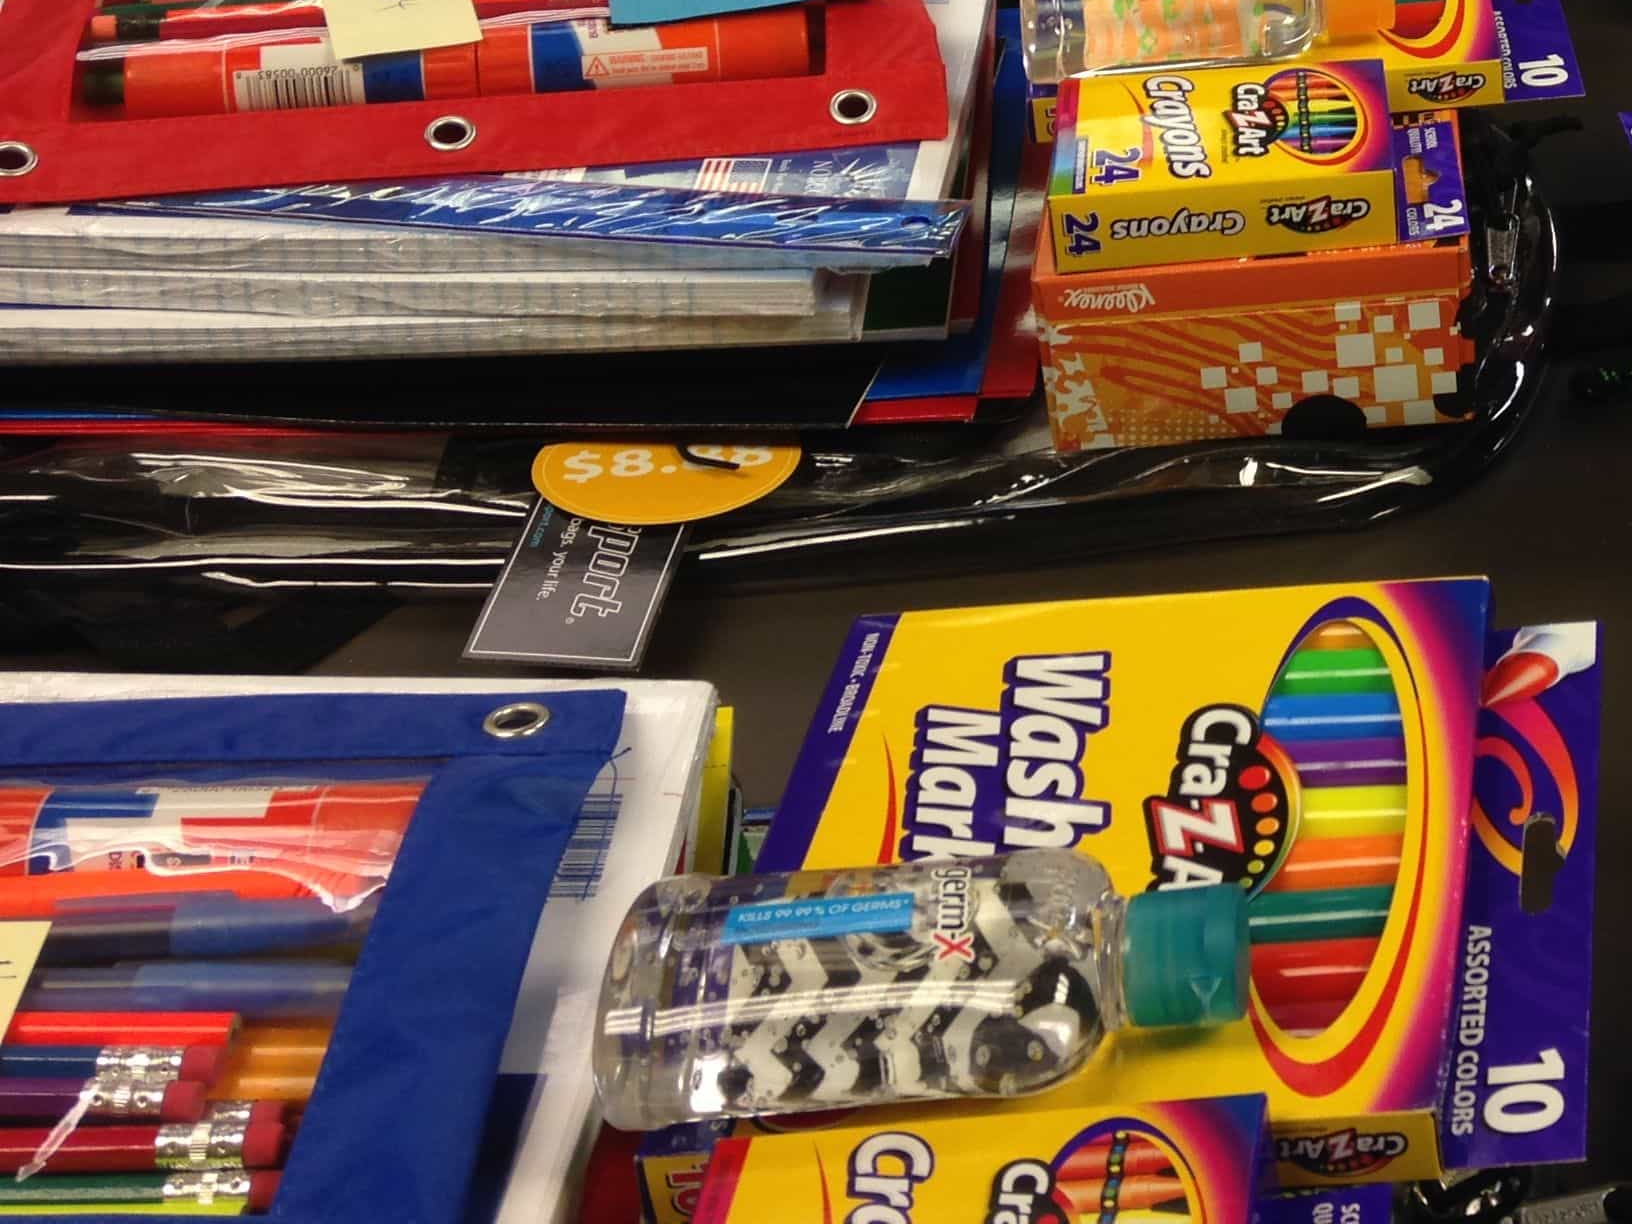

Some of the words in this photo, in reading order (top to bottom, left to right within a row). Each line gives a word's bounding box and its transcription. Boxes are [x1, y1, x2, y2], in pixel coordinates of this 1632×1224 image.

[1518, 54, 1569, 87] 10
[1144, 75, 1211, 178] Crayons
[1092, 146, 1144, 187] 24
[1111, 207, 1245, 239] Crayons
[1406, 206, 1420, 236] COLORS
[1423, 198, 1465, 232] 24
[1065, 212, 1101, 256] 24
[1063, 283, 1156, 313] Kleenex
[552, 550, 569, 577] your
[535, 577, 561, 601] life.
[1002, 652, 1110, 848] Wash
[737, 910, 772, 923] KILLS
[774, 906, 825, 919] 99.99%
[827, 903, 850, 916] OF
[1458, 924, 1493, 1047] ASSORTED
[1451, 1049, 1481, 1137] COLORS
[1483, 1047, 1566, 1135] 10
